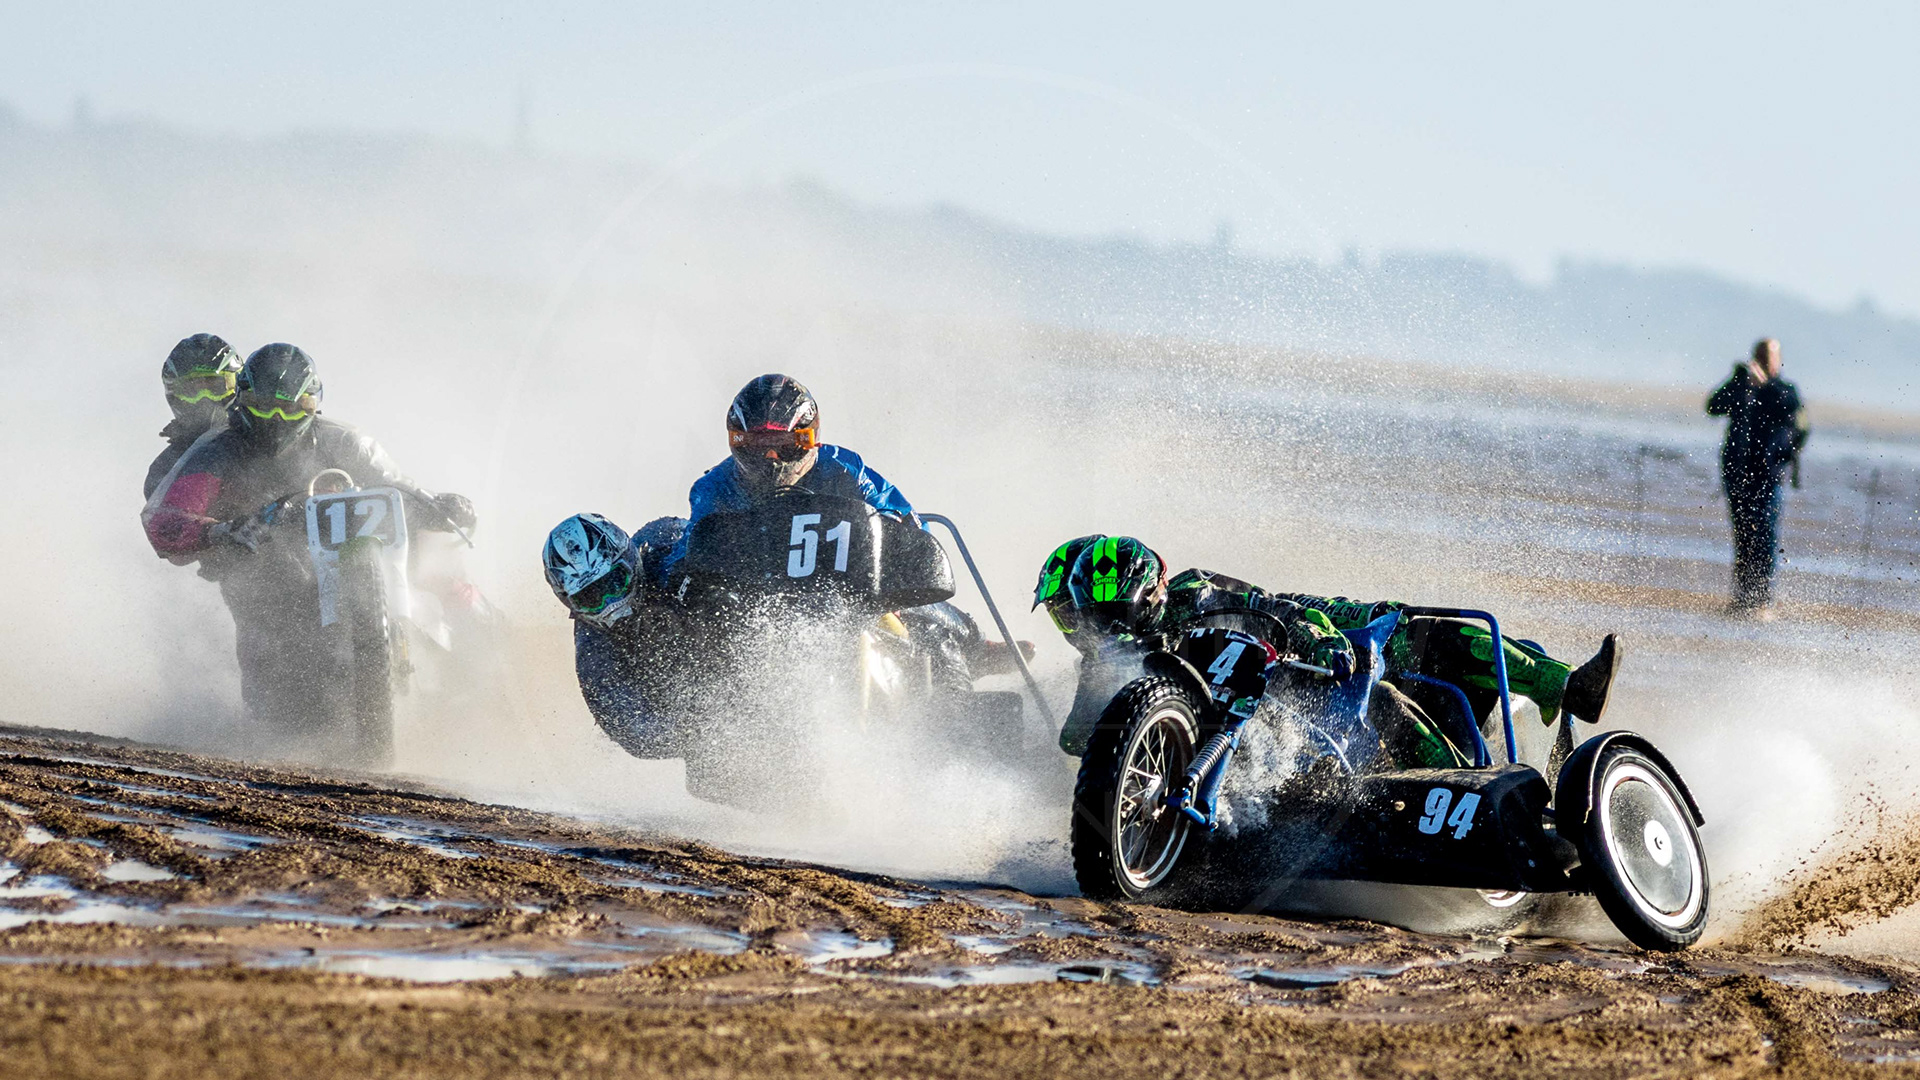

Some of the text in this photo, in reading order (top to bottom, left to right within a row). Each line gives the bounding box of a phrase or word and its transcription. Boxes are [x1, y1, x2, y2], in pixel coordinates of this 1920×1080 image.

[325, 499, 387, 544] 12
[787, 513, 851, 578] 51
[1207, 641, 1247, 685] 4
[1418, 787, 1482, 840] 94
